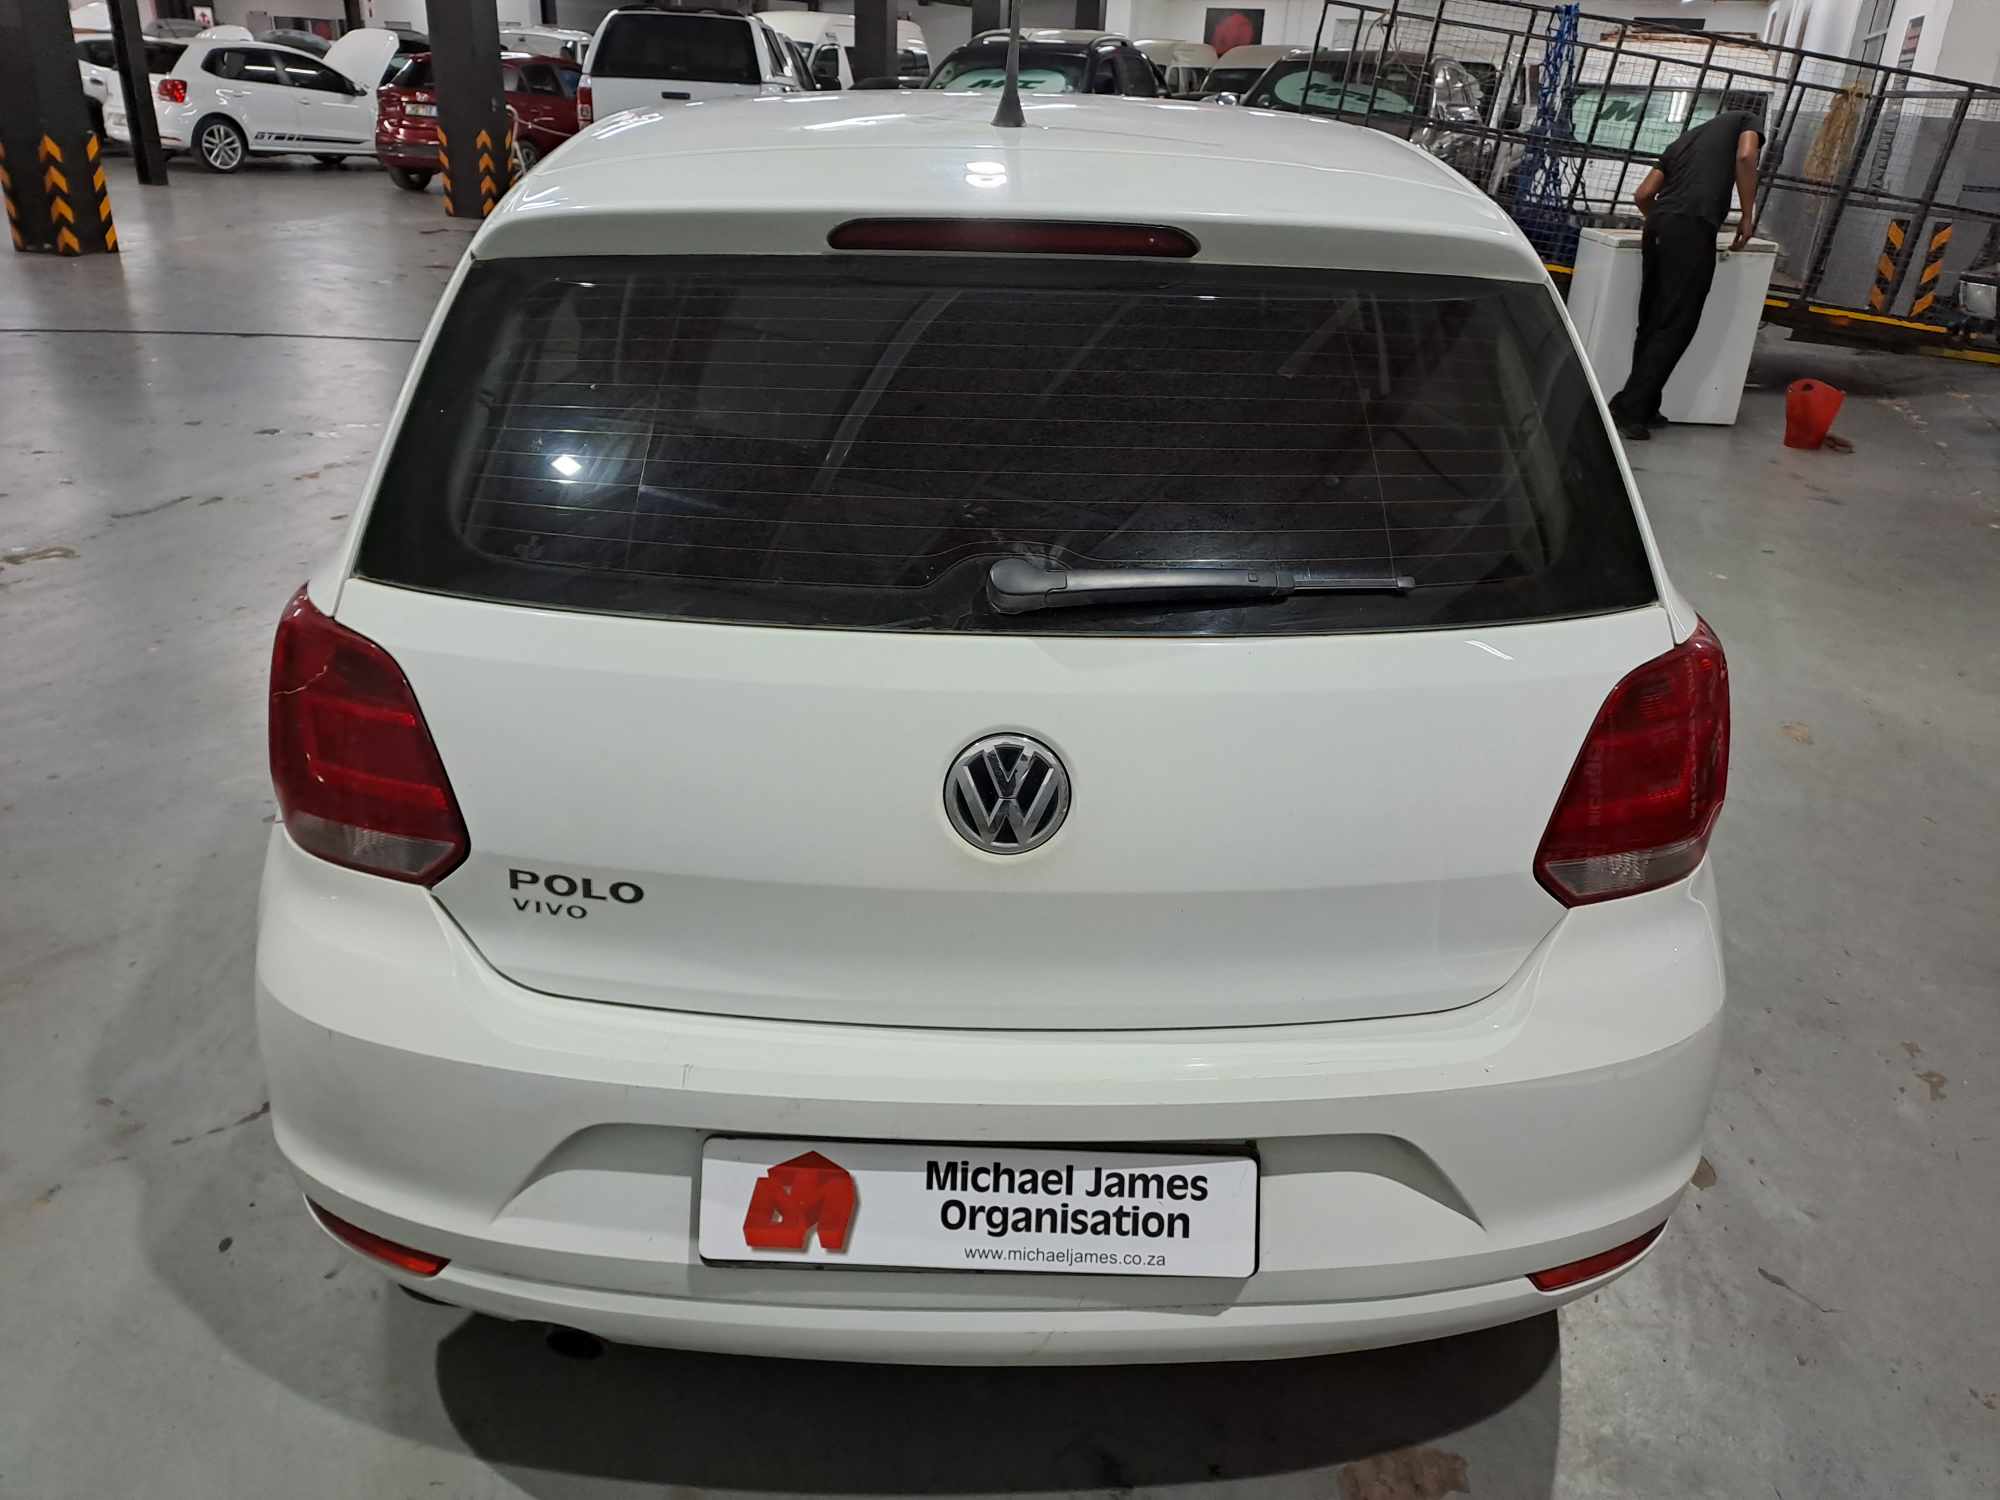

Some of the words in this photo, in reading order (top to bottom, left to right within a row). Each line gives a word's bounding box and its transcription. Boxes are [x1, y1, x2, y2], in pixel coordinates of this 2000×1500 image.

[943, 732, 1072, 855] VW
[508, 868, 645, 904] POLO
[513, 897, 588, 919] VIVO
[926, 1160, 1074, 1196] Michael
[1085, 1167, 1209, 1201] James
[940, 1199, 1190, 1238] Organisation
[964, 1247, 1166, 1267] www.michaeljames.co.za
